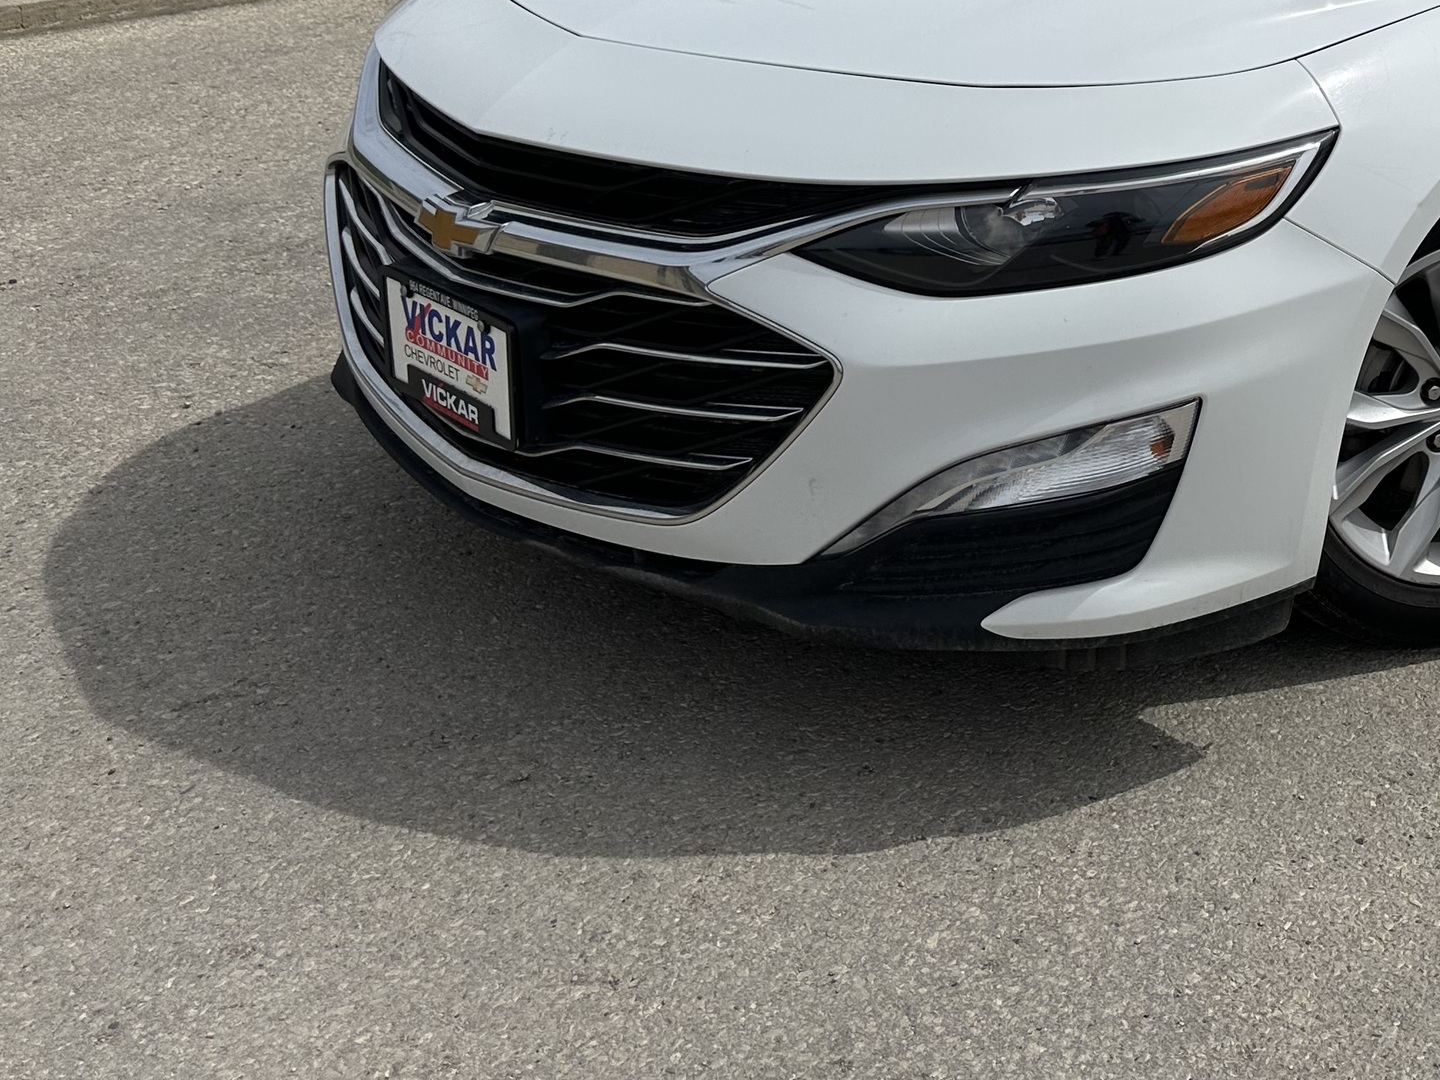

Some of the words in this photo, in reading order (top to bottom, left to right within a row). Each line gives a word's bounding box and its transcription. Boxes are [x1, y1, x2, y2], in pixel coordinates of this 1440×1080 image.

[401, 296, 497, 372] VICKAR
[406, 329, 489, 380] COMMUNITY
[404, 344, 460, 382] CHEVROLET
[421, 378, 479, 424] VICKAR
